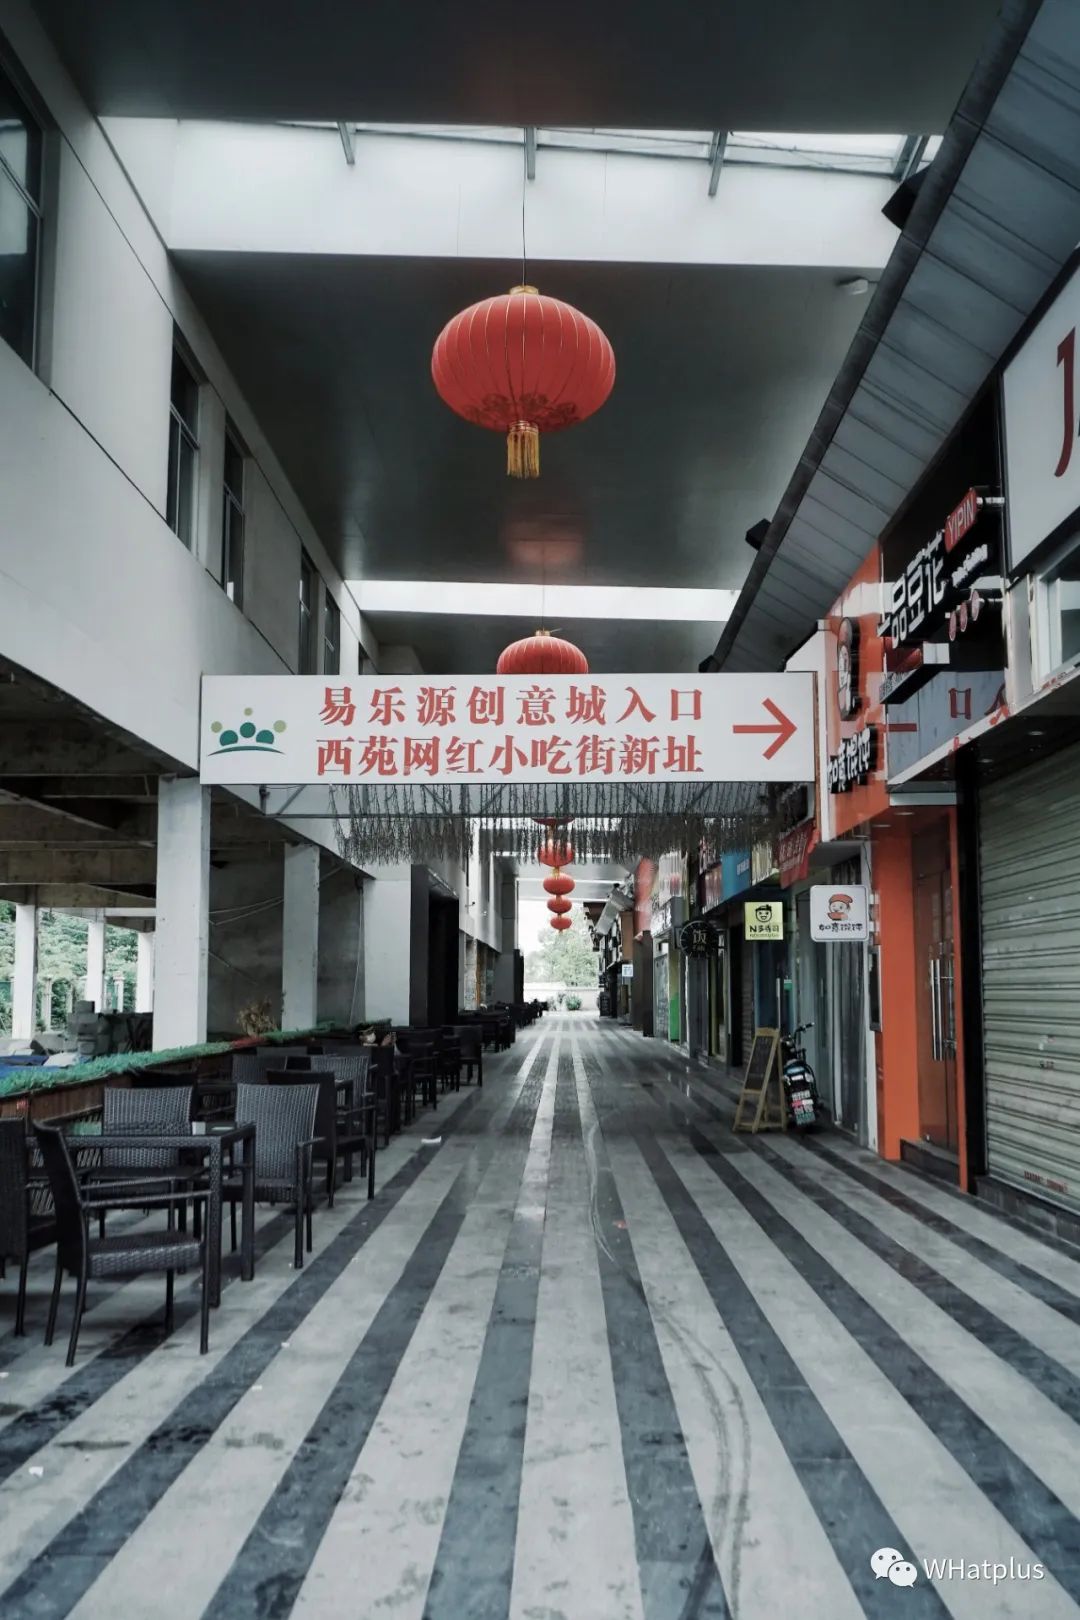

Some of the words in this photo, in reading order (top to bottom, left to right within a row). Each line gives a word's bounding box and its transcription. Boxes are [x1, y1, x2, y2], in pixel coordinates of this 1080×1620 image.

[946, 498, 976, 545] YIPIN
[877, 529, 947, 649] 一品豆花
[318, 685, 704, 727] 易乐源创意城入口
[315, 734, 705, 777] 西苑网红小吃街新址
